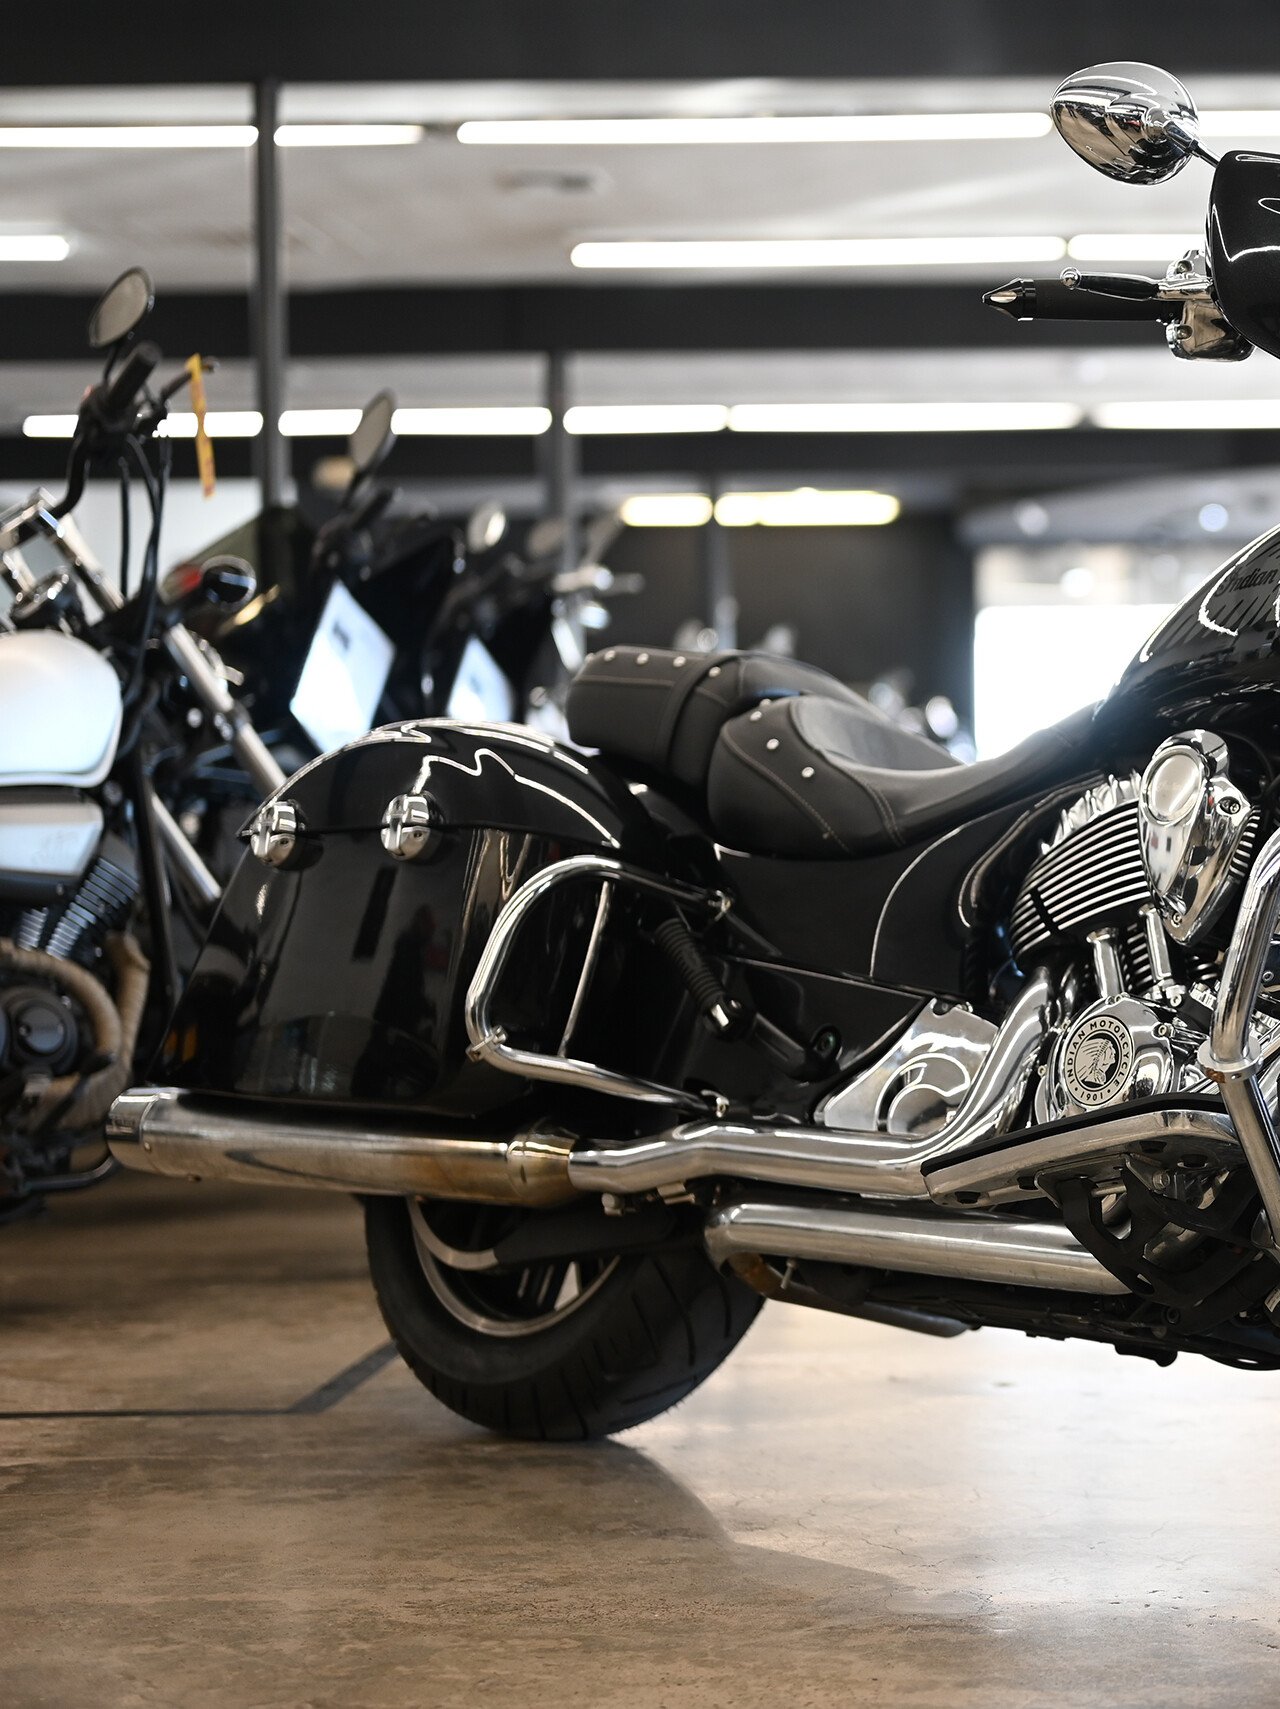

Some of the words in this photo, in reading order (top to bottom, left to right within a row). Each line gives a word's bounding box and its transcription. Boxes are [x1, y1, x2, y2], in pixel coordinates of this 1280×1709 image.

[1213, 566, 1279, 598] Indian
[1066, 1030, 1087, 1085] INDIAN
[1089, 1019, 1130, 1087] MOTORCYCLE
[1080, 1091, 1104, 1101] 1901
